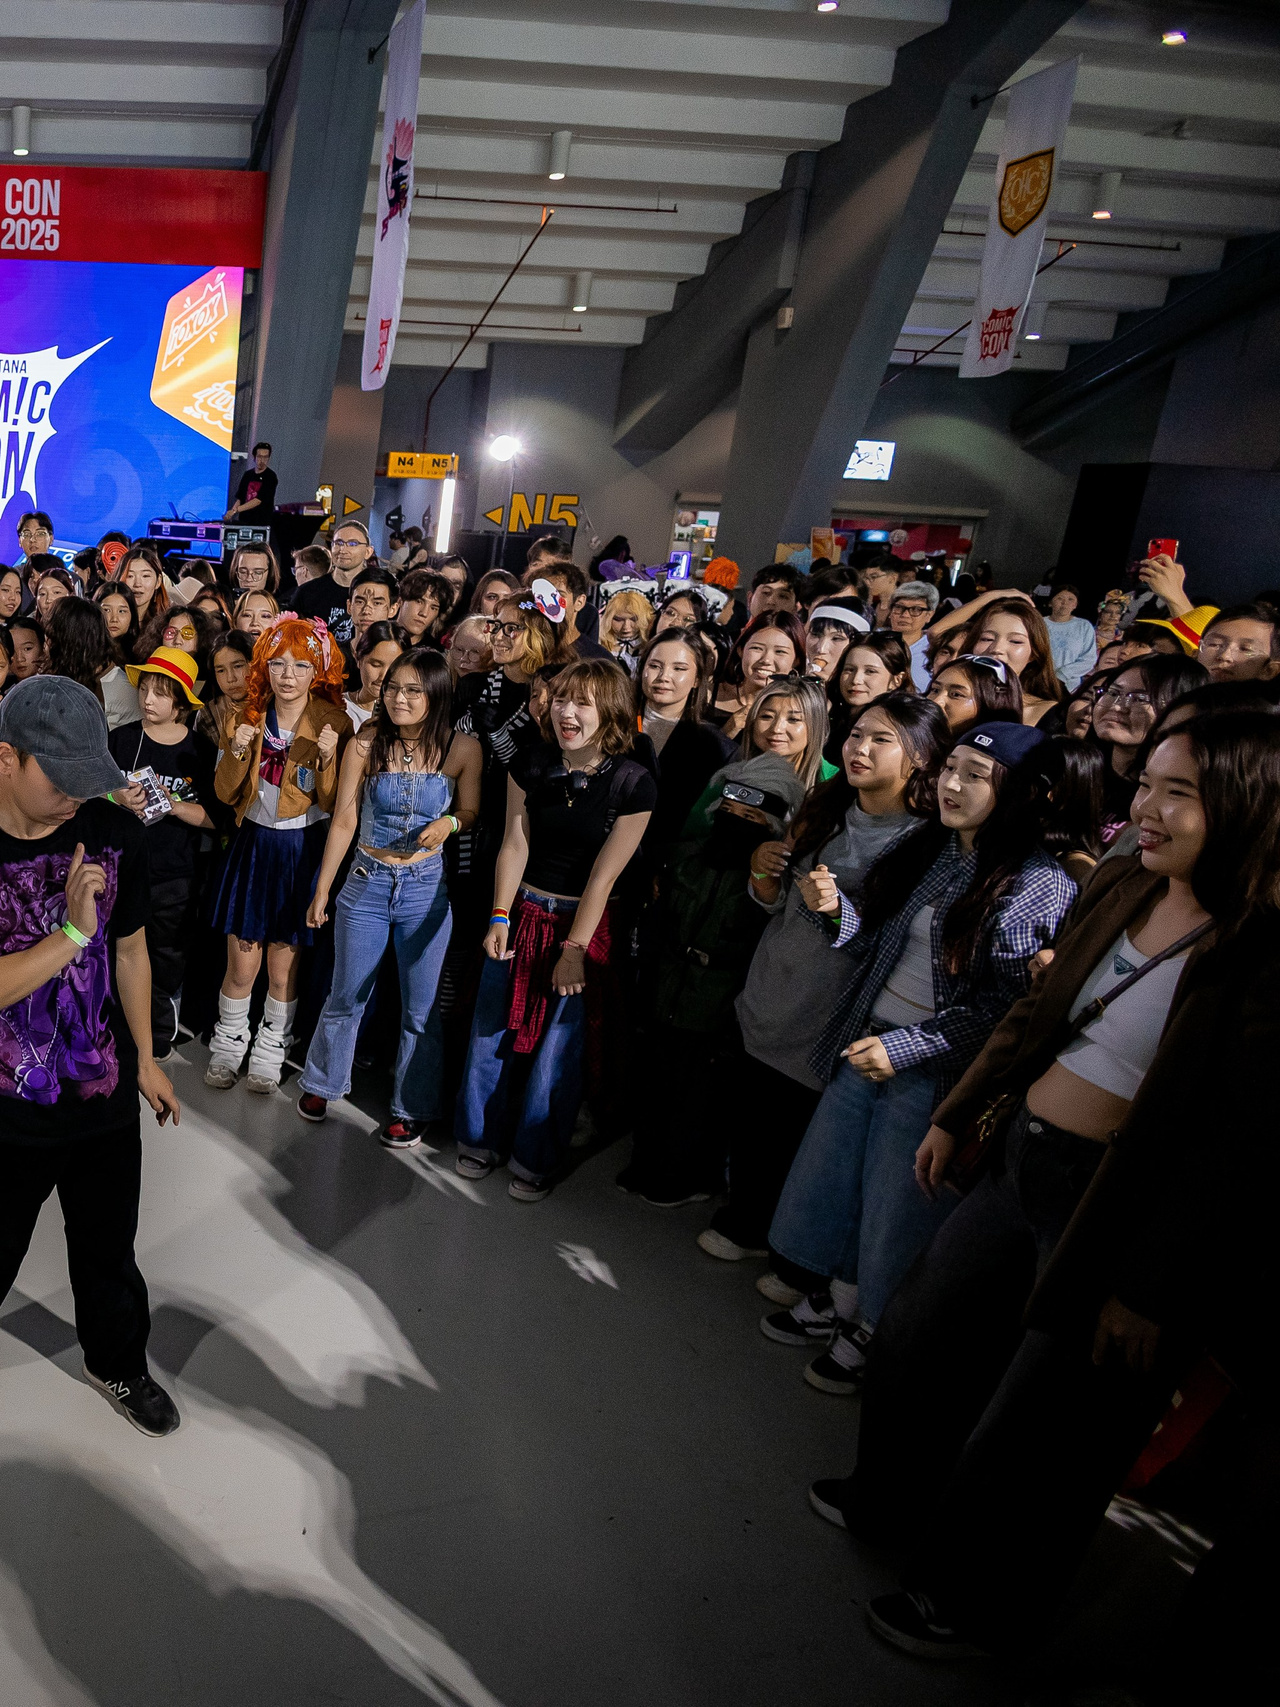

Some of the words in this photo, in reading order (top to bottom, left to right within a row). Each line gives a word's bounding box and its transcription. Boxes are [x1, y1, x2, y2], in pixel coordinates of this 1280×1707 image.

[5, 178, 61, 216] CON
[0, 218, 60, 251] 2025
[982, 331, 1009, 355] CON
[397, 456, 414, 466] N4
[432, 458, 449, 468] N5
[508, 493, 580, 533] N5
